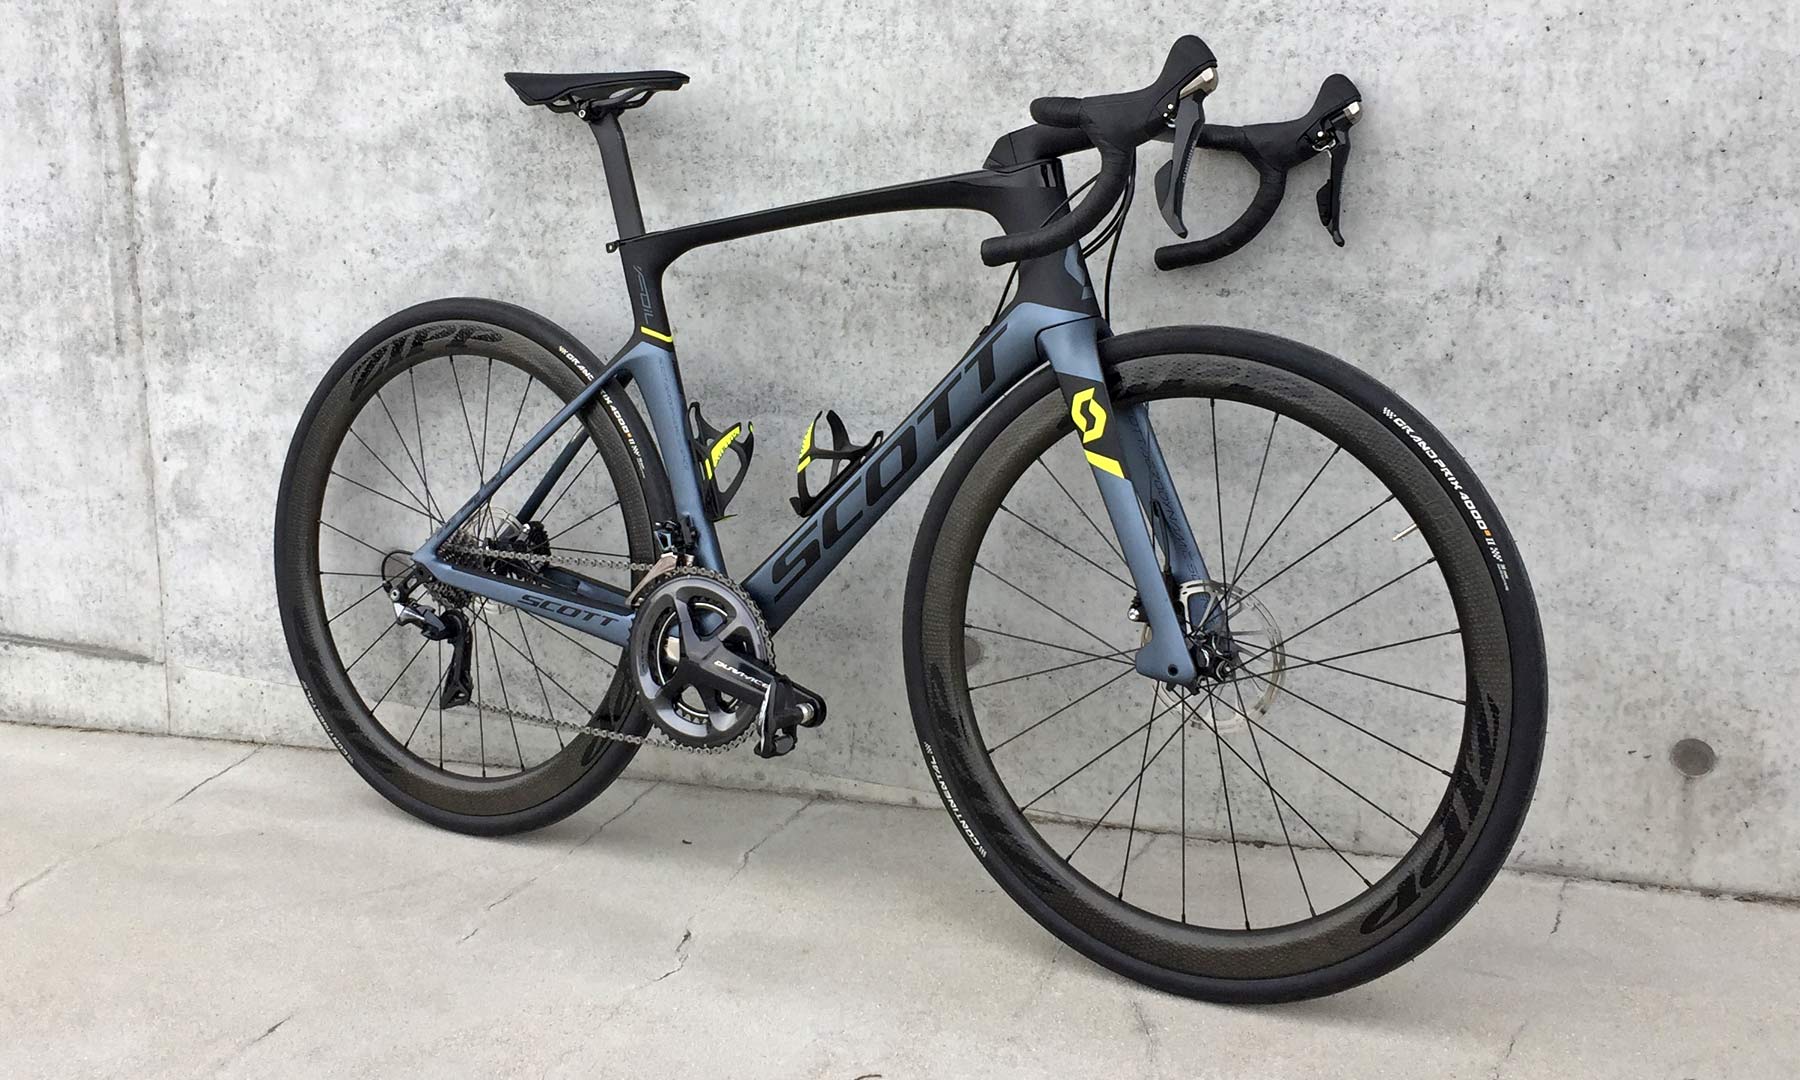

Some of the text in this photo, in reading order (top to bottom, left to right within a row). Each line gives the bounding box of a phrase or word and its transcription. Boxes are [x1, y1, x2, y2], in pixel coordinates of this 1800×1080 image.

[771, 322, 1008, 604] SCOTT
[1393, 417, 1438, 459] GRAND
[1434, 459, 1463, 491] PRIX
[517, 594, 619, 626] SCOTT
[930, 755, 980, 847] CONTINENTAL
